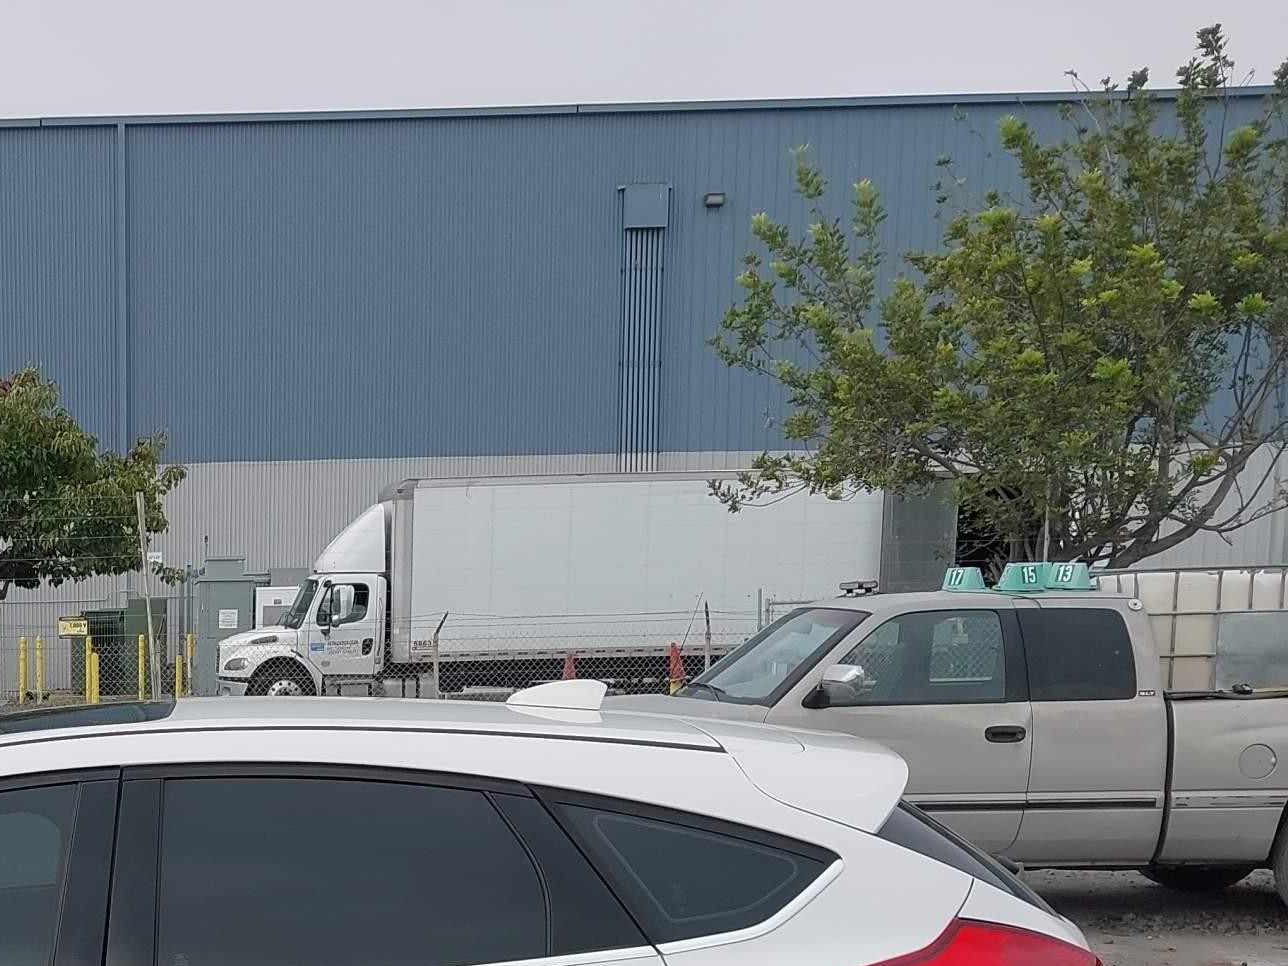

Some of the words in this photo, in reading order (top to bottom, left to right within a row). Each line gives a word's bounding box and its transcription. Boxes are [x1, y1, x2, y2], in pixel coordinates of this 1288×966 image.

[950, 569, 964, 585] 17
[1023, 566, 1036, 583] 15
[1057, 565, 1073, 582] 13
